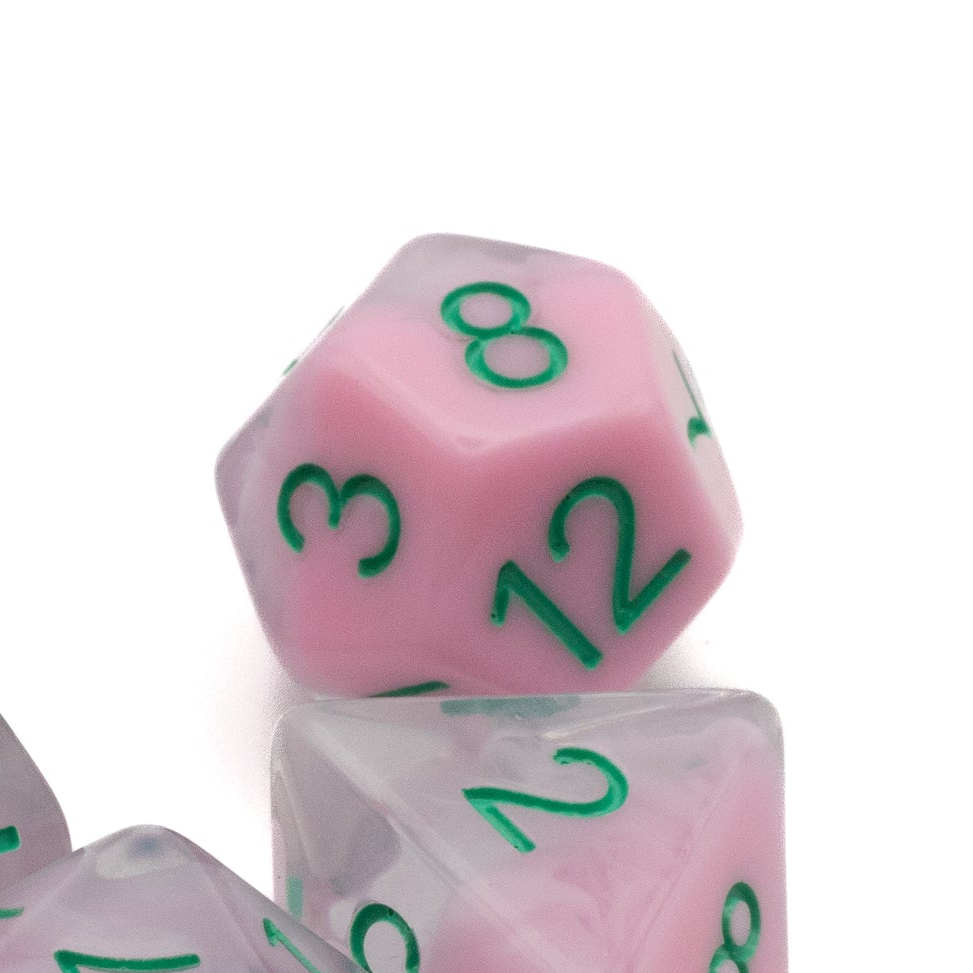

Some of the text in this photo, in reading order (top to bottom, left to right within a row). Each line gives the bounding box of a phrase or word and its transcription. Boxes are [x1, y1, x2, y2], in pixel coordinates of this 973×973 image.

[440, 280, 569, 390] 8
[276, 463, 402, 579] 3
[489, 476, 692, 672] 12
[461, 746, 630, 854] 2
